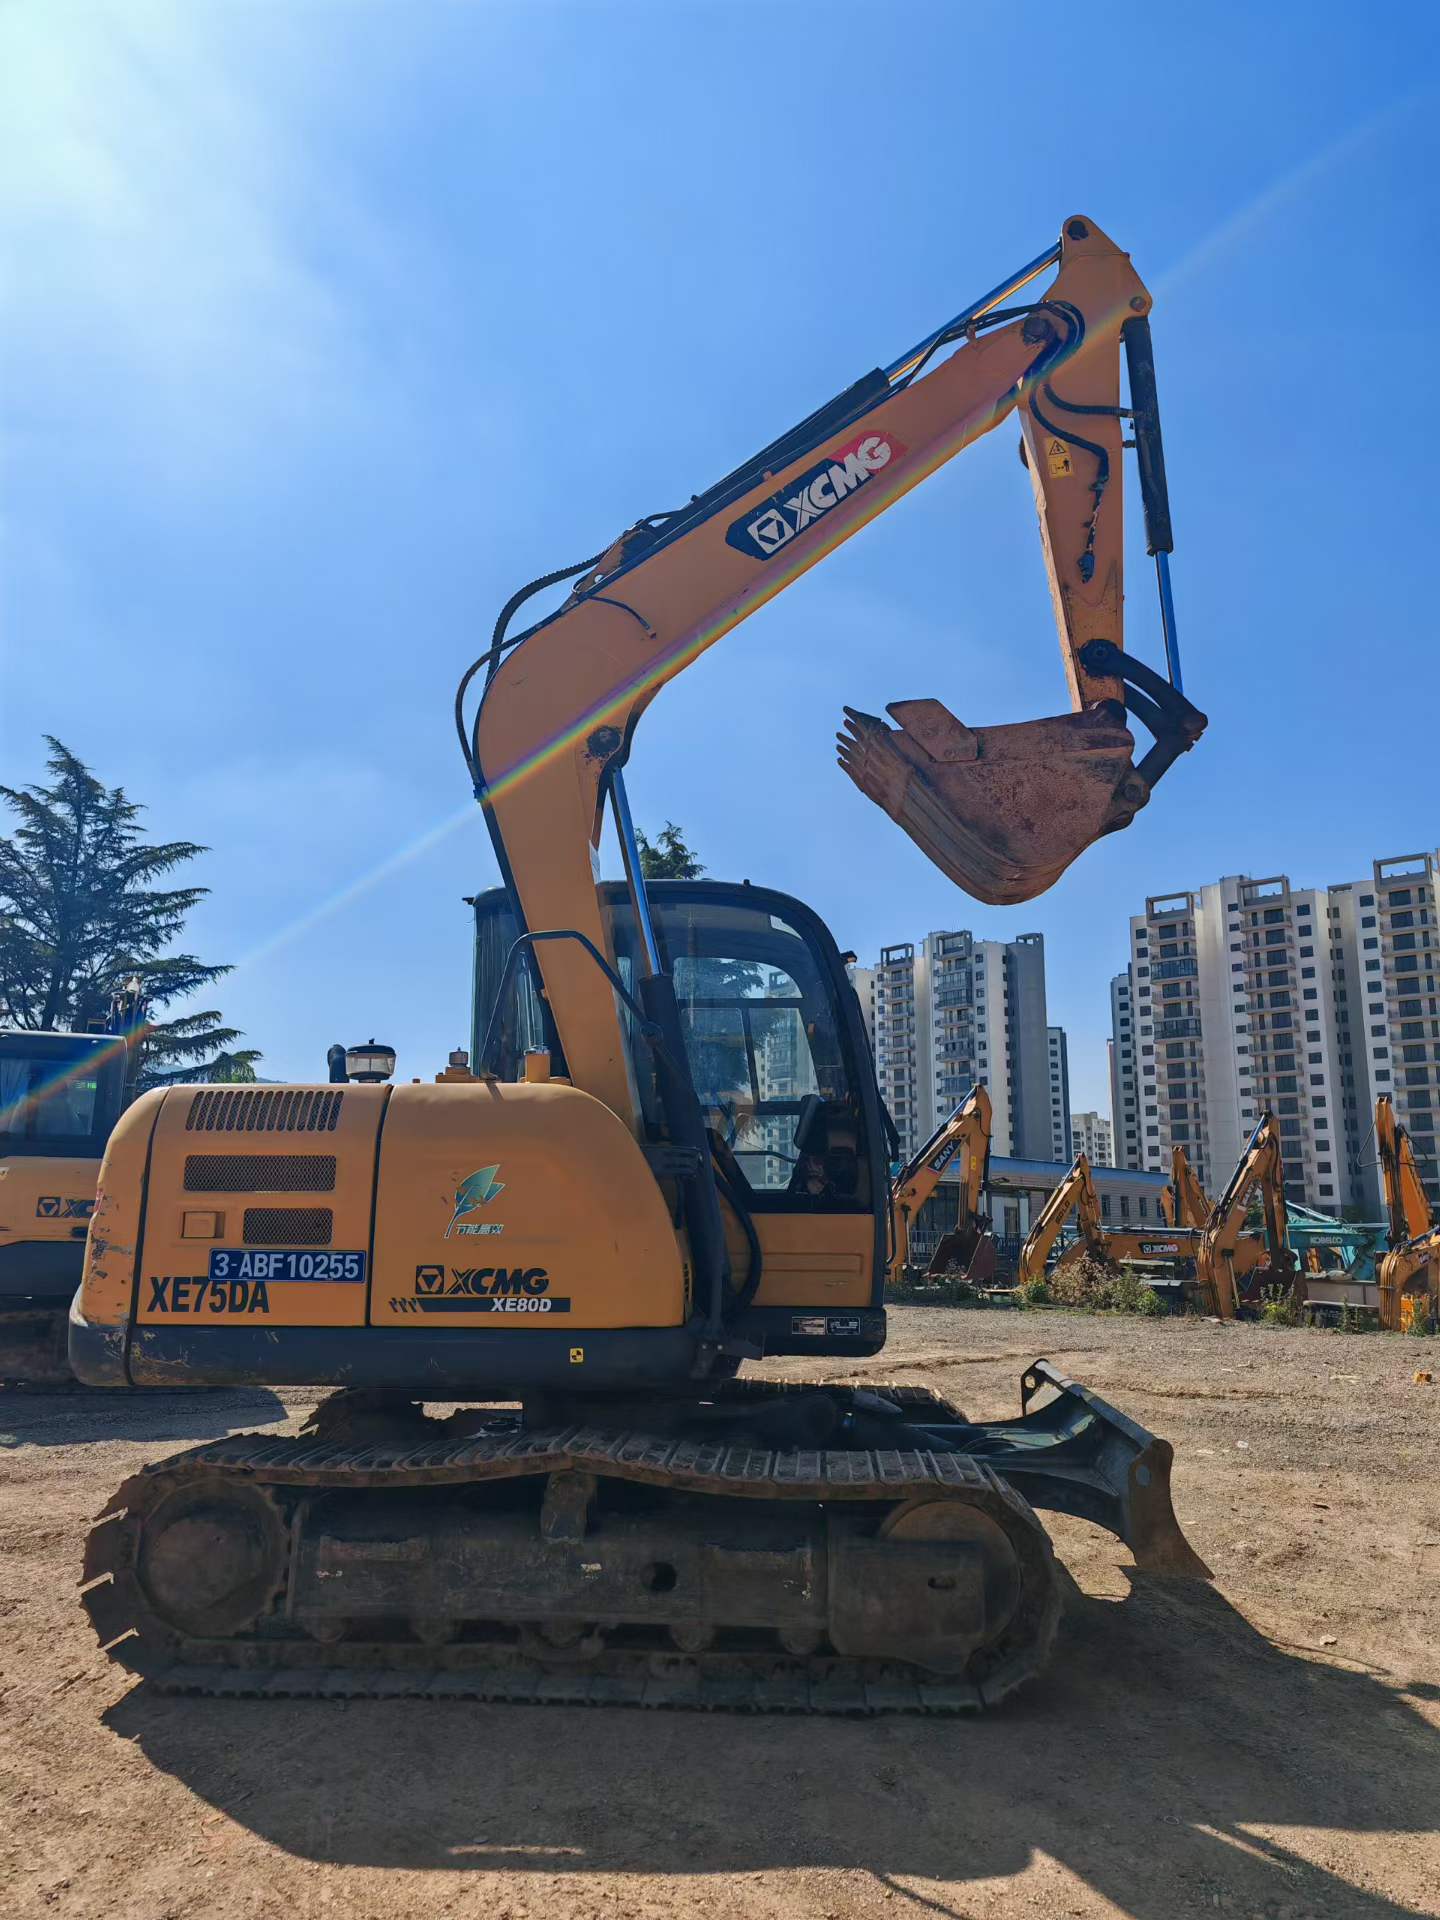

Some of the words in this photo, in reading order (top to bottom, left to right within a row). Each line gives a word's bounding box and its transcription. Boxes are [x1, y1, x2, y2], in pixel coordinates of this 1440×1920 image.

[783, 436, 891, 533] XCMG
[934, 1141, 955, 1170] SANY
[61, 1199, 95, 1218] XC
[1151, 1243, 1178, 1253] XCMG
[1310, 1236, 1343, 1245] KOBELCO
[444, 1267, 550, 1296] XCMG
[147, 1275, 270, 1314] XE75DA
[491, 1297, 552, 1312] XE80D
